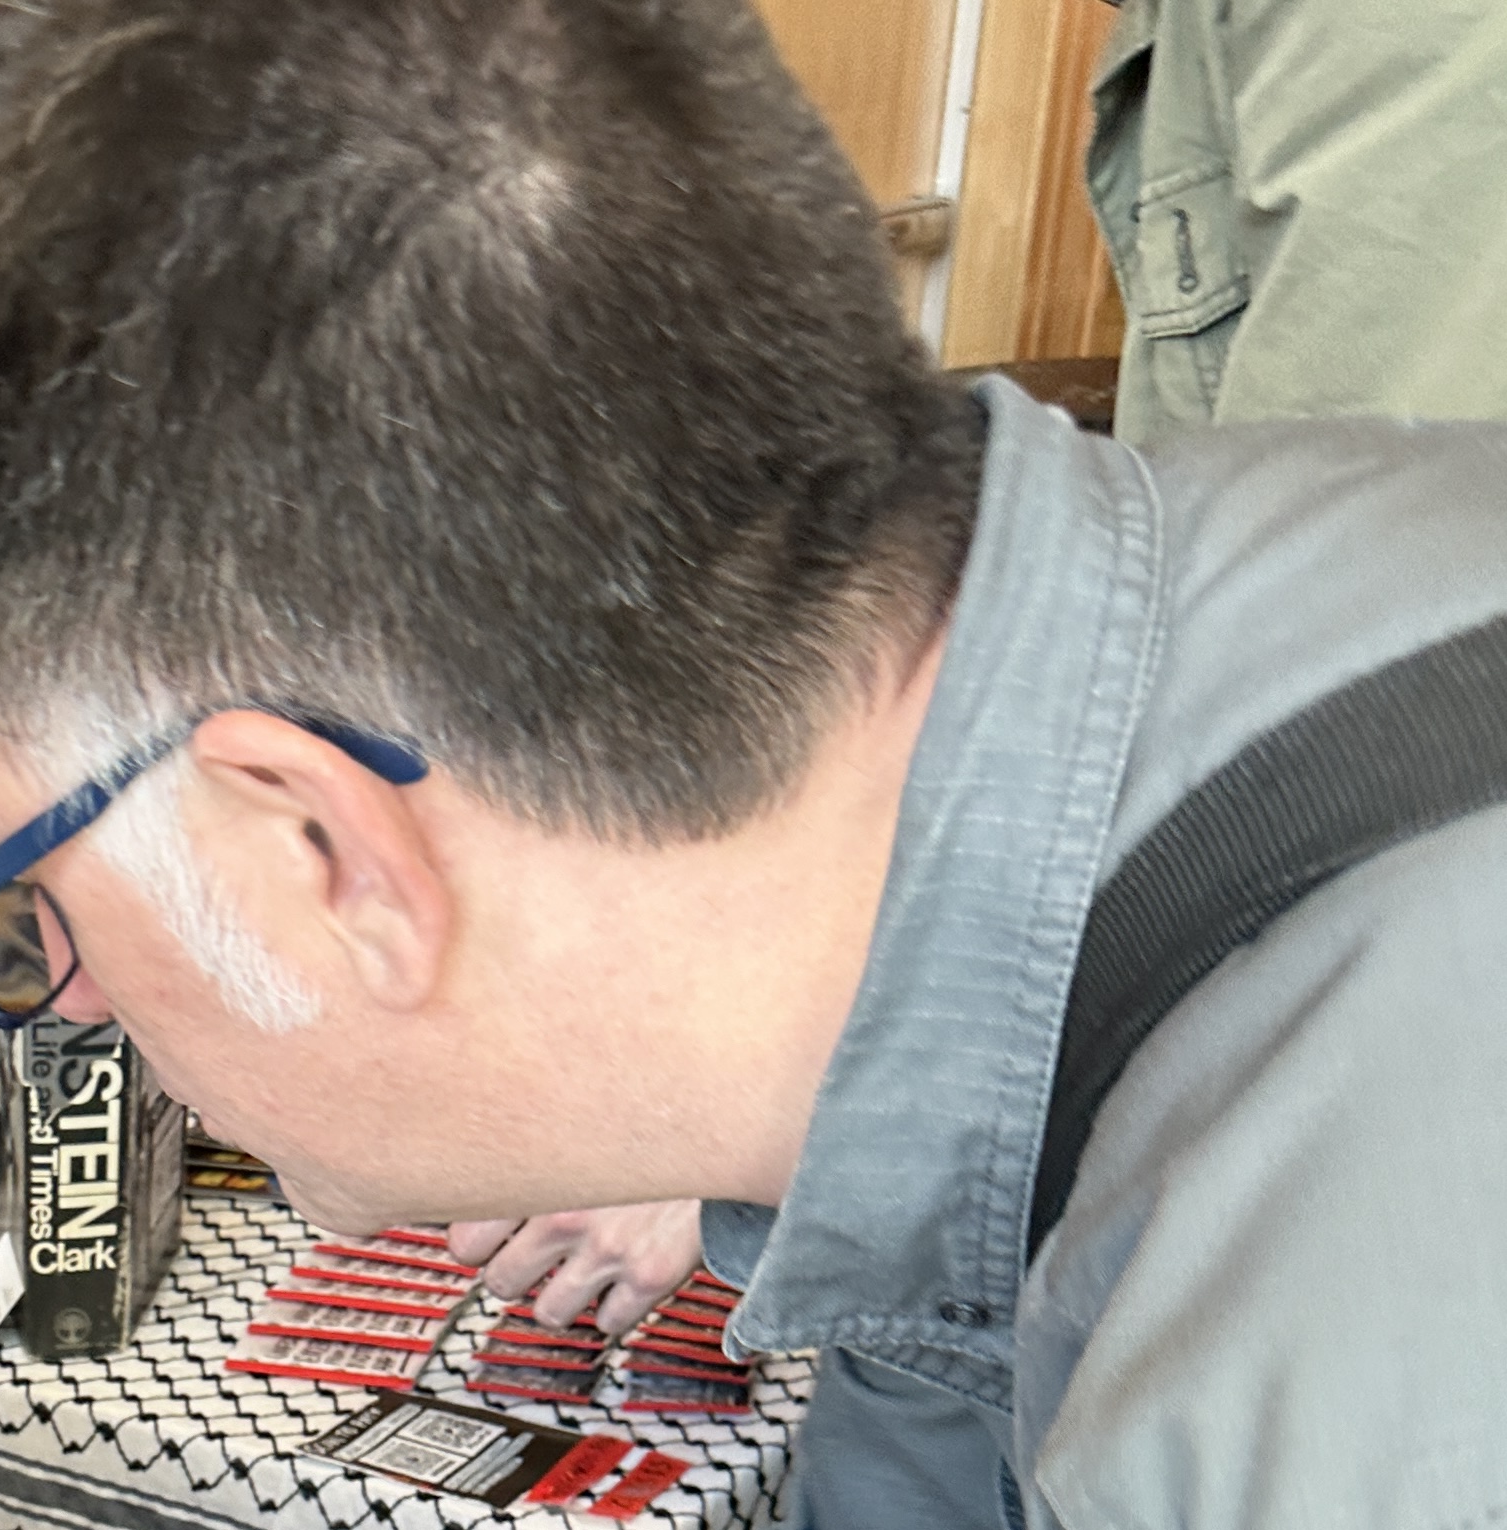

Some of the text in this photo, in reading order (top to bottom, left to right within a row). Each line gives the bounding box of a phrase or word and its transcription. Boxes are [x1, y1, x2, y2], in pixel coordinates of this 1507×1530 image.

[58, 1022, 124, 1240] NSTEIN
[29, 1149, 58, 1241] Times
[30, 1241, 117, 1275] Clark
